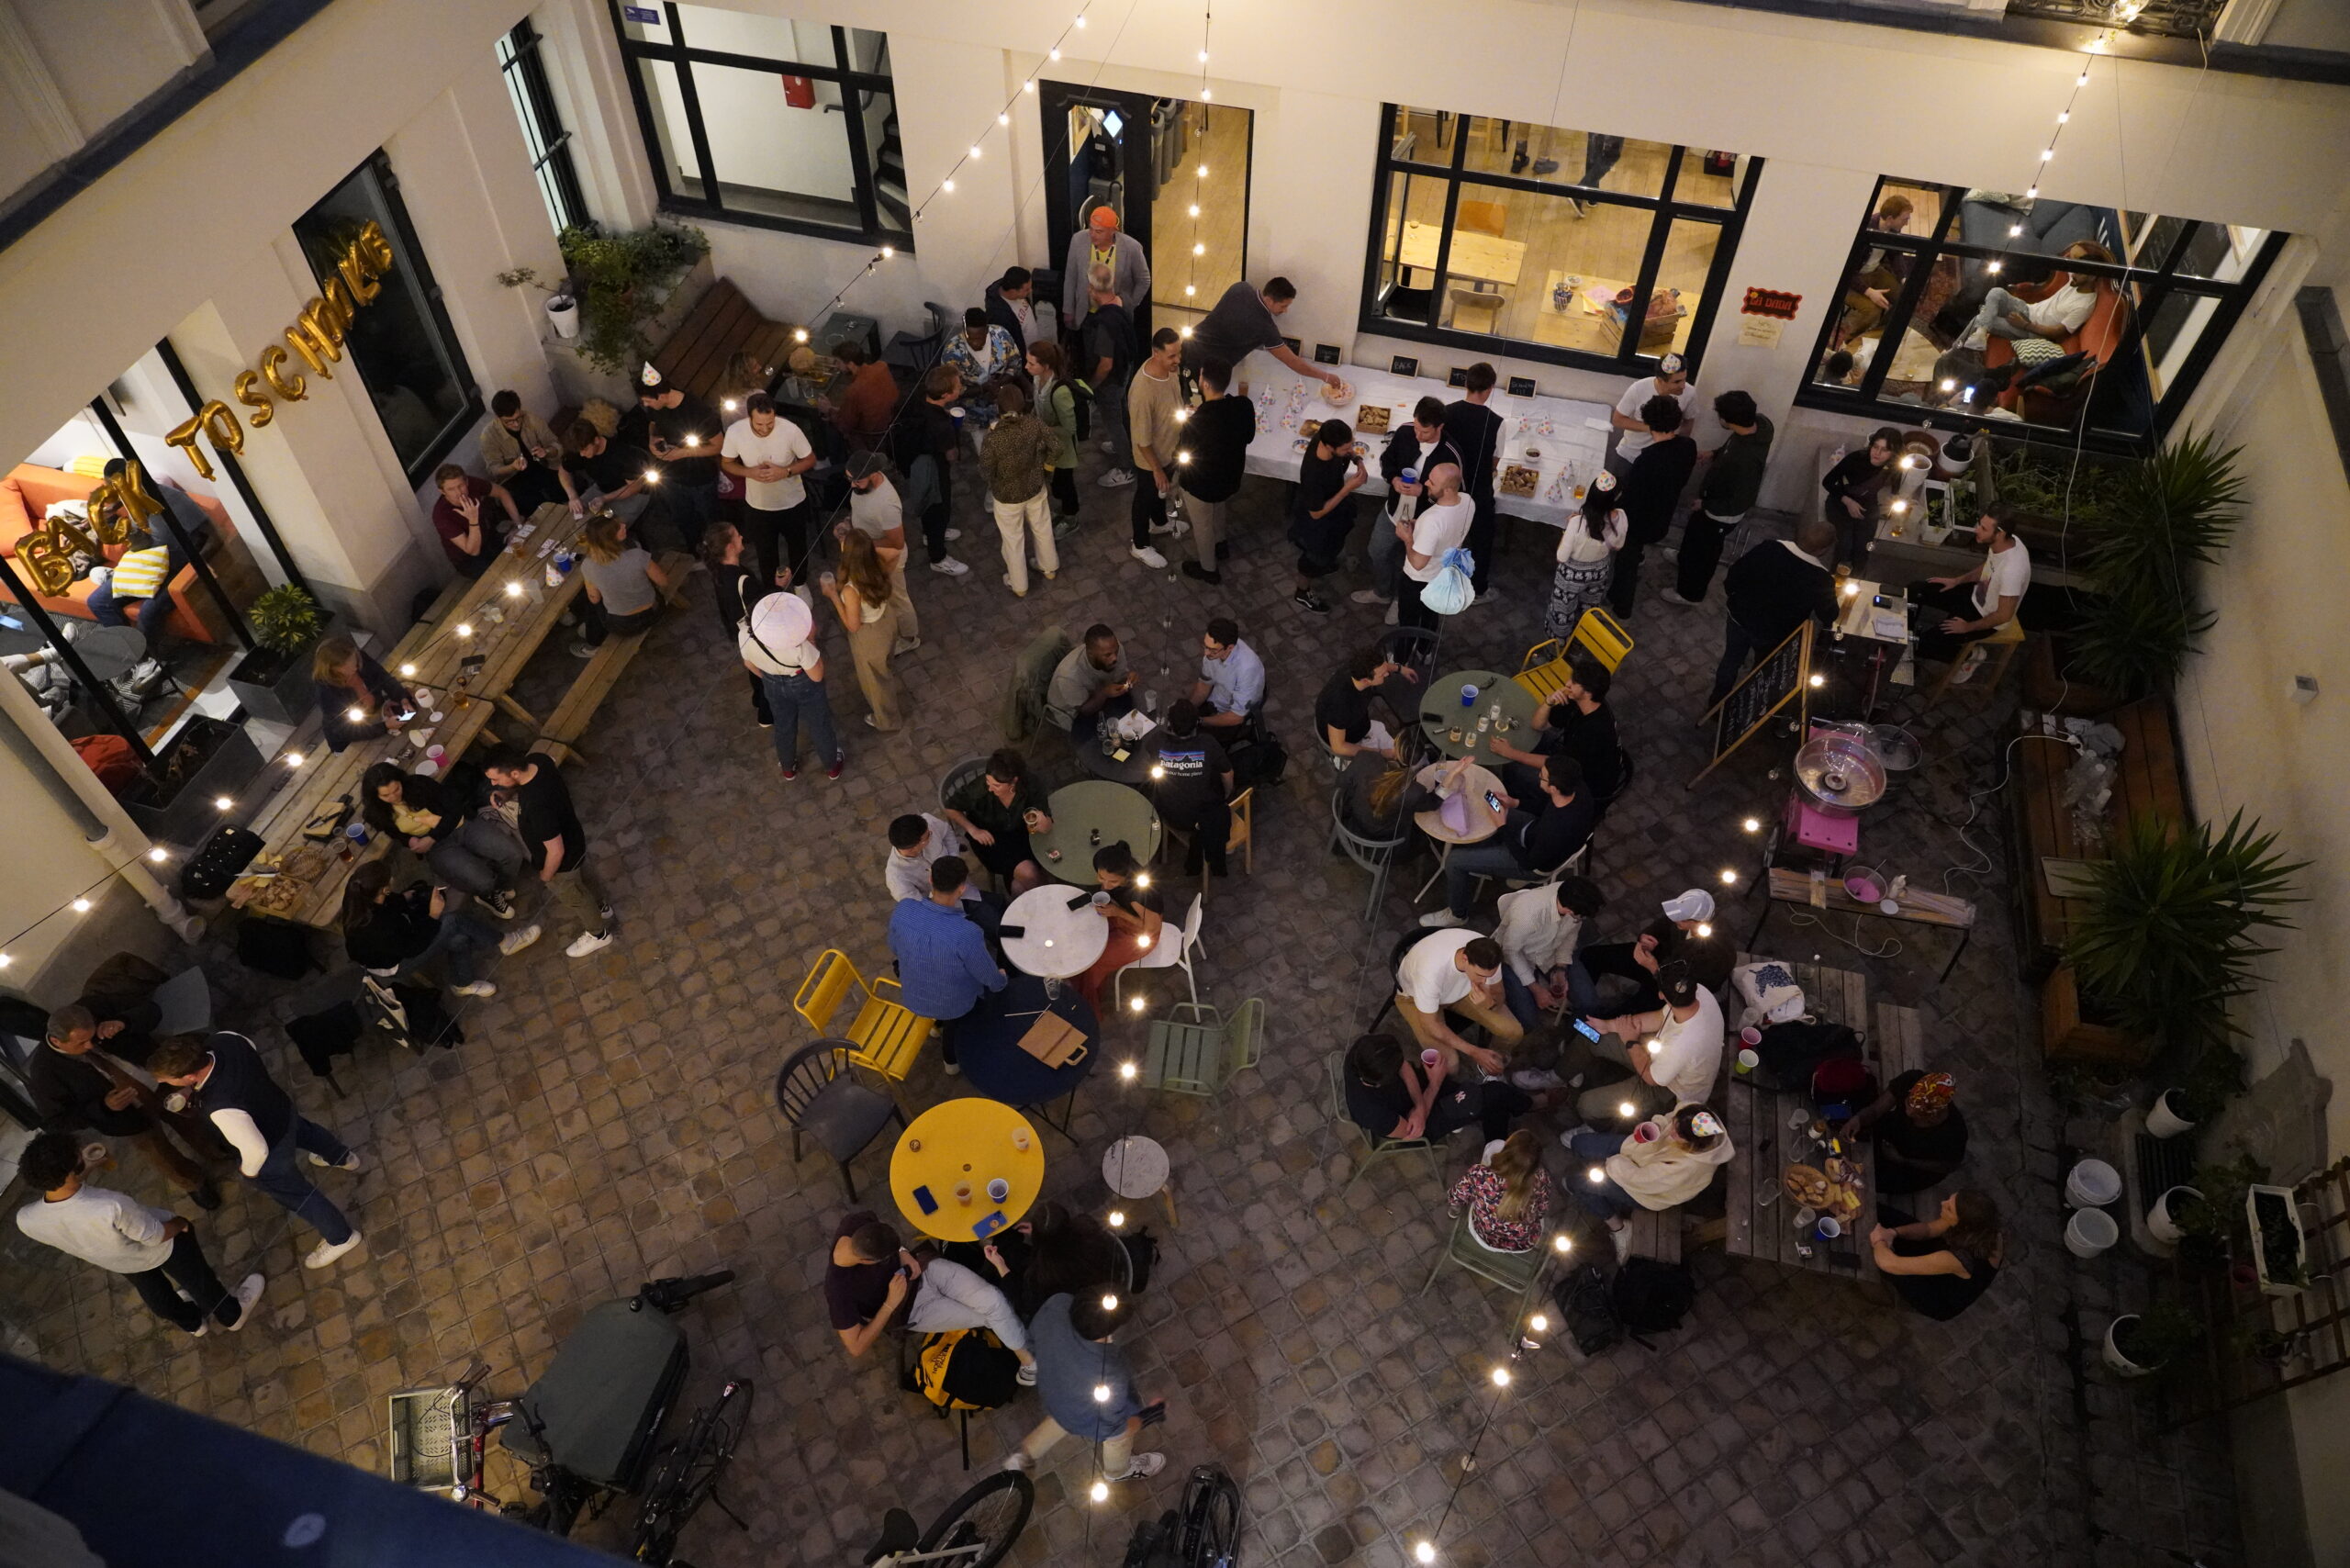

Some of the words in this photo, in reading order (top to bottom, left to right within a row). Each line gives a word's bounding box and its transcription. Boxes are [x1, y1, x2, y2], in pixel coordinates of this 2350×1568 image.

[15, 460, 165, 599] BACK
[165, 399, 244, 482] TO
[235, 260, 382, 429] SCHOOL
[1160, 760, 1203, 770] patagonia
